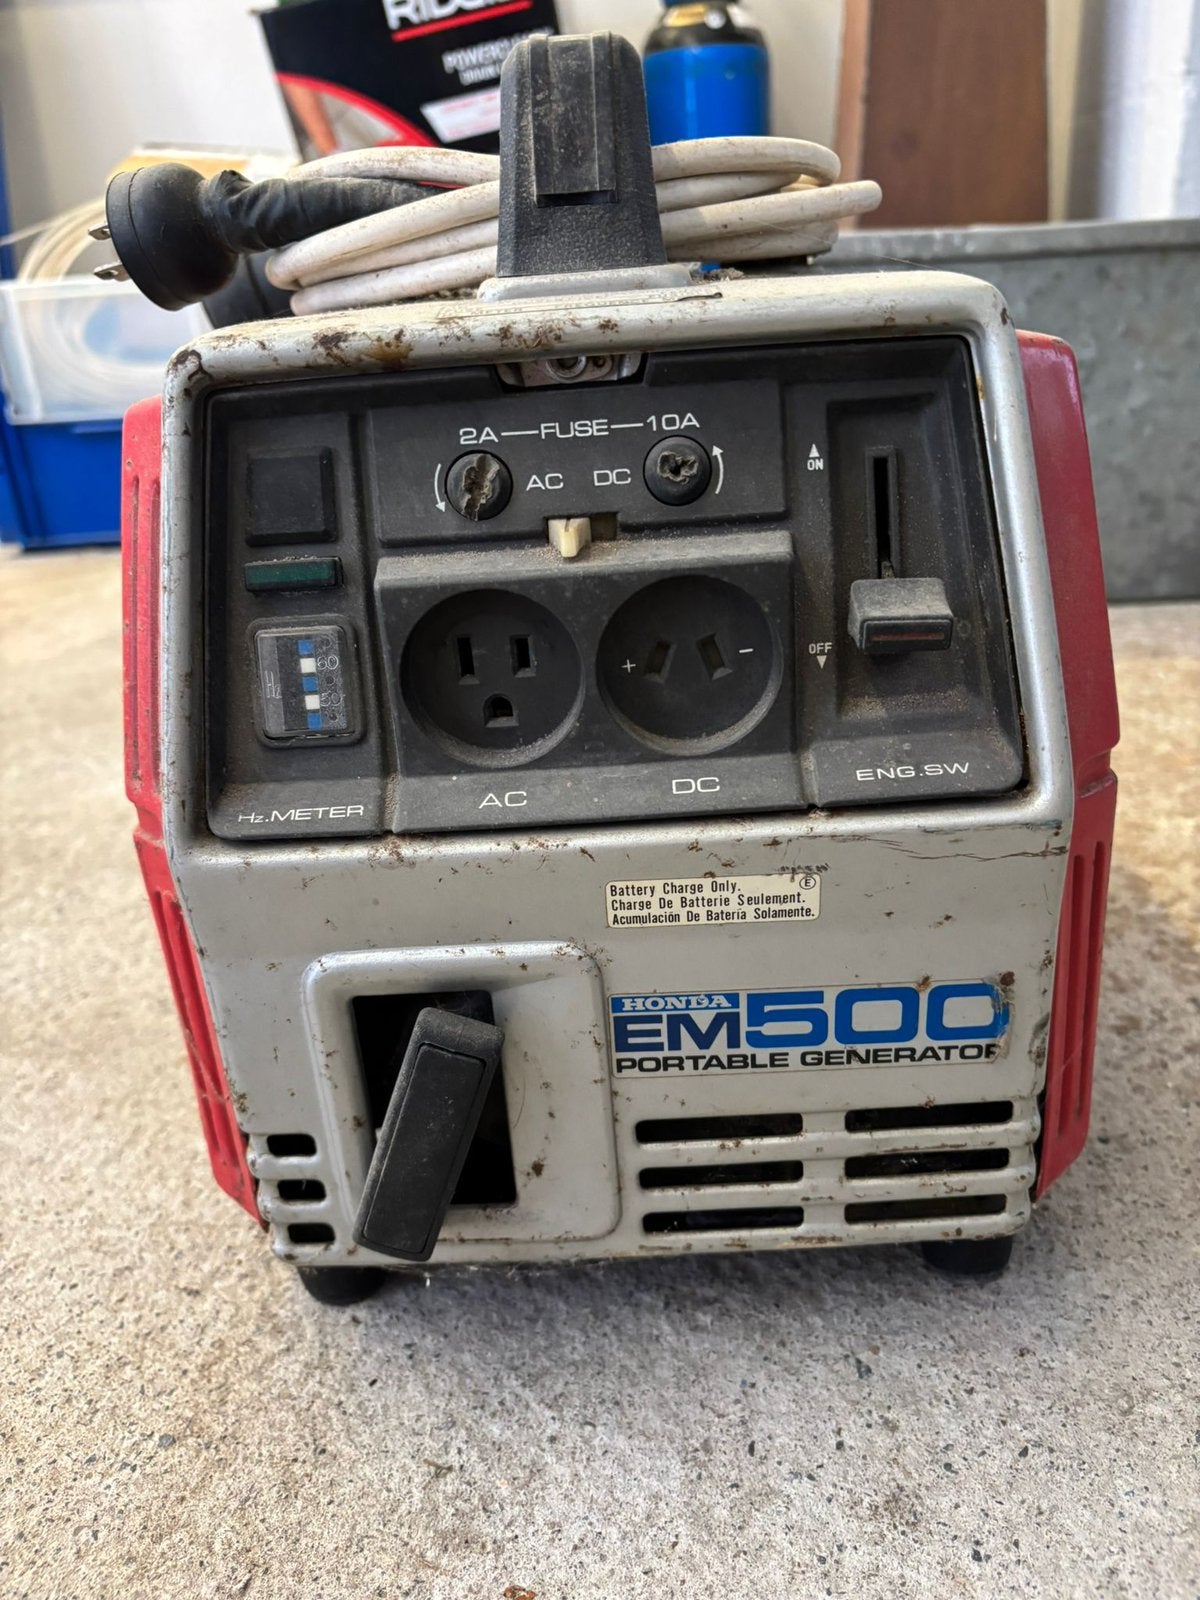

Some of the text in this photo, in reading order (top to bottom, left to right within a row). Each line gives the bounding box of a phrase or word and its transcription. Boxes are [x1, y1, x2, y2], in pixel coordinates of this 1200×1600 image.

[459, 413, 700, 445] 2A FUSE 10A
[807, 459, 824, 471] ON
[526, 473, 564, 492] AC
[593, 468, 632, 487] DC
[808, 643, 832, 655] OFF
[856, 762, 969, 782] ENG.SW
[671, 776, 721, 795] DC
[478, 790, 528, 809] AC
[238, 804, 365, 823] Hz.METER
[610, 880, 741, 898] Battery Charge Only.
[611, 892, 806, 912] Charge De Batterie Seulement.
[612, 905, 815, 926] Acumulación De Batería Solamente.
[622, 993, 732, 1011] HONDA
[616, 1052, 790, 1073] PORTABLE
